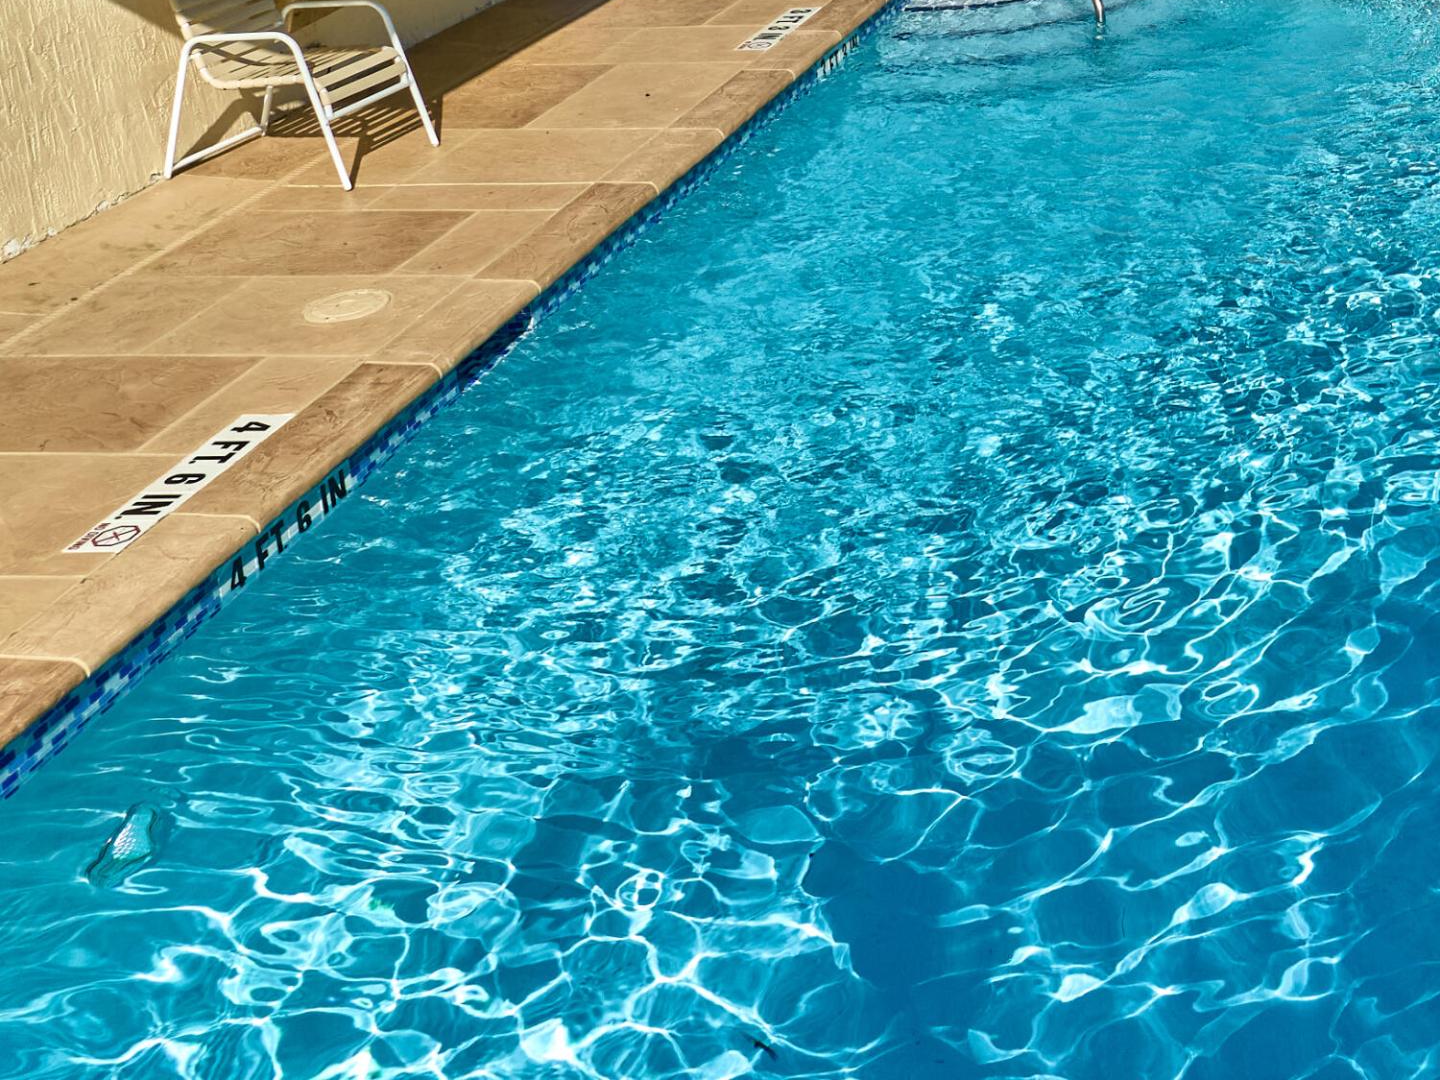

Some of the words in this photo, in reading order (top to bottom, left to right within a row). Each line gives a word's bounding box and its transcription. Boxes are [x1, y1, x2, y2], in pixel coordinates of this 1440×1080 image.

[230, 420, 271, 434] 4
[188, 440, 250, 465] FT.
[163, 473, 207, 485] 6
[115, 494, 182, 520] IN.
[230, 560, 247, 591] 4
[255, 524, 289, 570] FT.
[296, 500, 312, 533] 6
[320, 469, 352, 515] IN.
